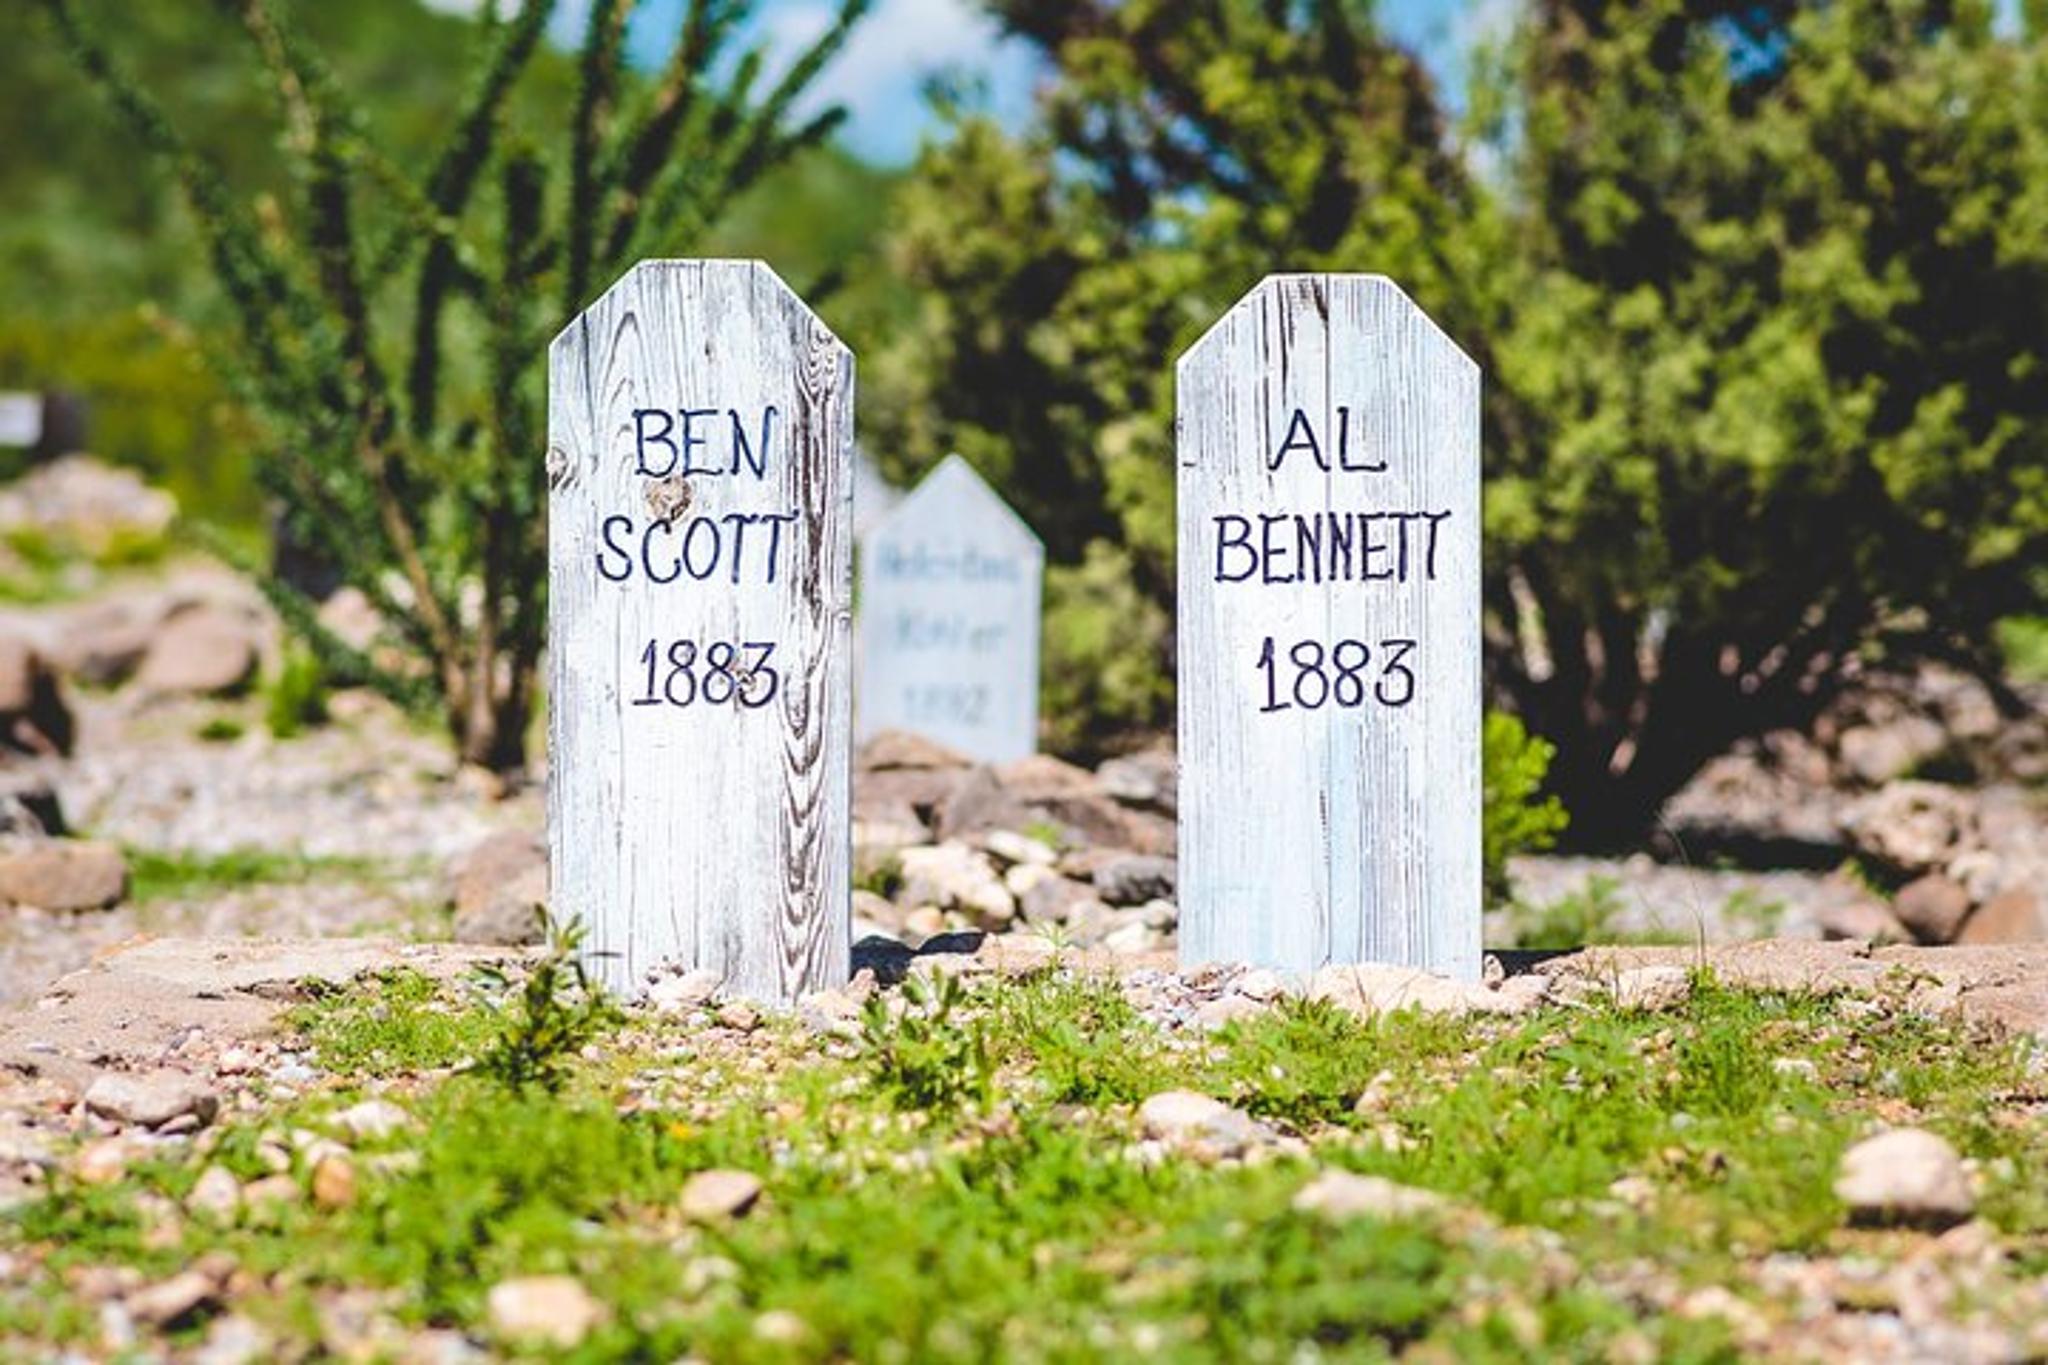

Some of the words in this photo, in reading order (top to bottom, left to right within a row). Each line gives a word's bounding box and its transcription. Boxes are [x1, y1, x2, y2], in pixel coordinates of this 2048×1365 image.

[632, 406, 778, 480] BEN
[1267, 406, 1387, 472] AL
[596, 509, 799, 583] SCOTT
[1212, 510, 1451, 583] BENNETT
[632, 638, 778, 708] 1883
[1256, 636, 1417, 712] 1883
